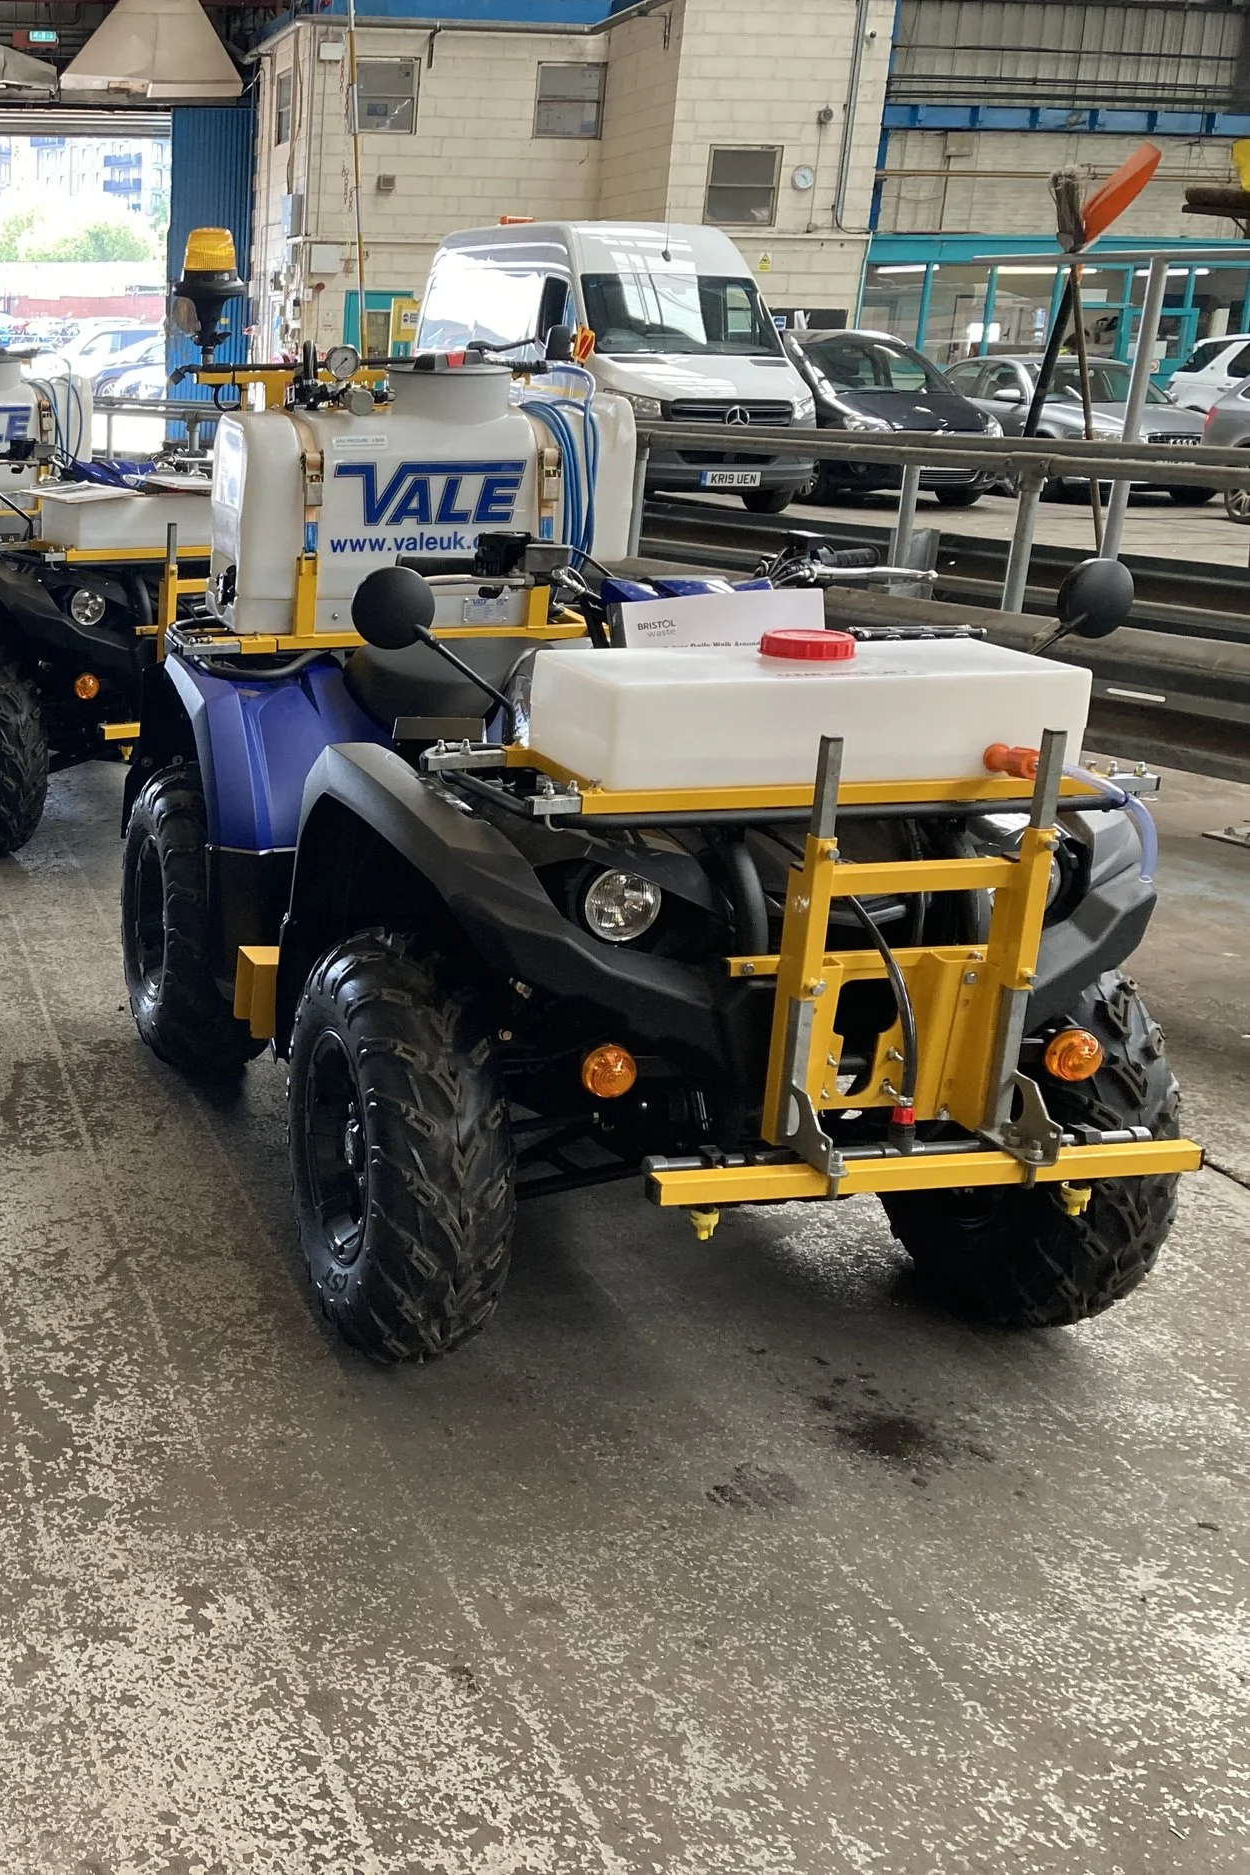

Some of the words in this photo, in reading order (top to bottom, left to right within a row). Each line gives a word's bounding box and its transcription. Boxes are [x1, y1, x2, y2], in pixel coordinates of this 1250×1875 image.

[710, 473, 735, 485] KR19
[736, 473, 757, 485] UEN
[333, 460, 527, 526] VALE
[330, 531, 478, 553] www.valeuk.
[637, 619, 677, 631] BRISTOL
[646, 628, 676, 638] waste
